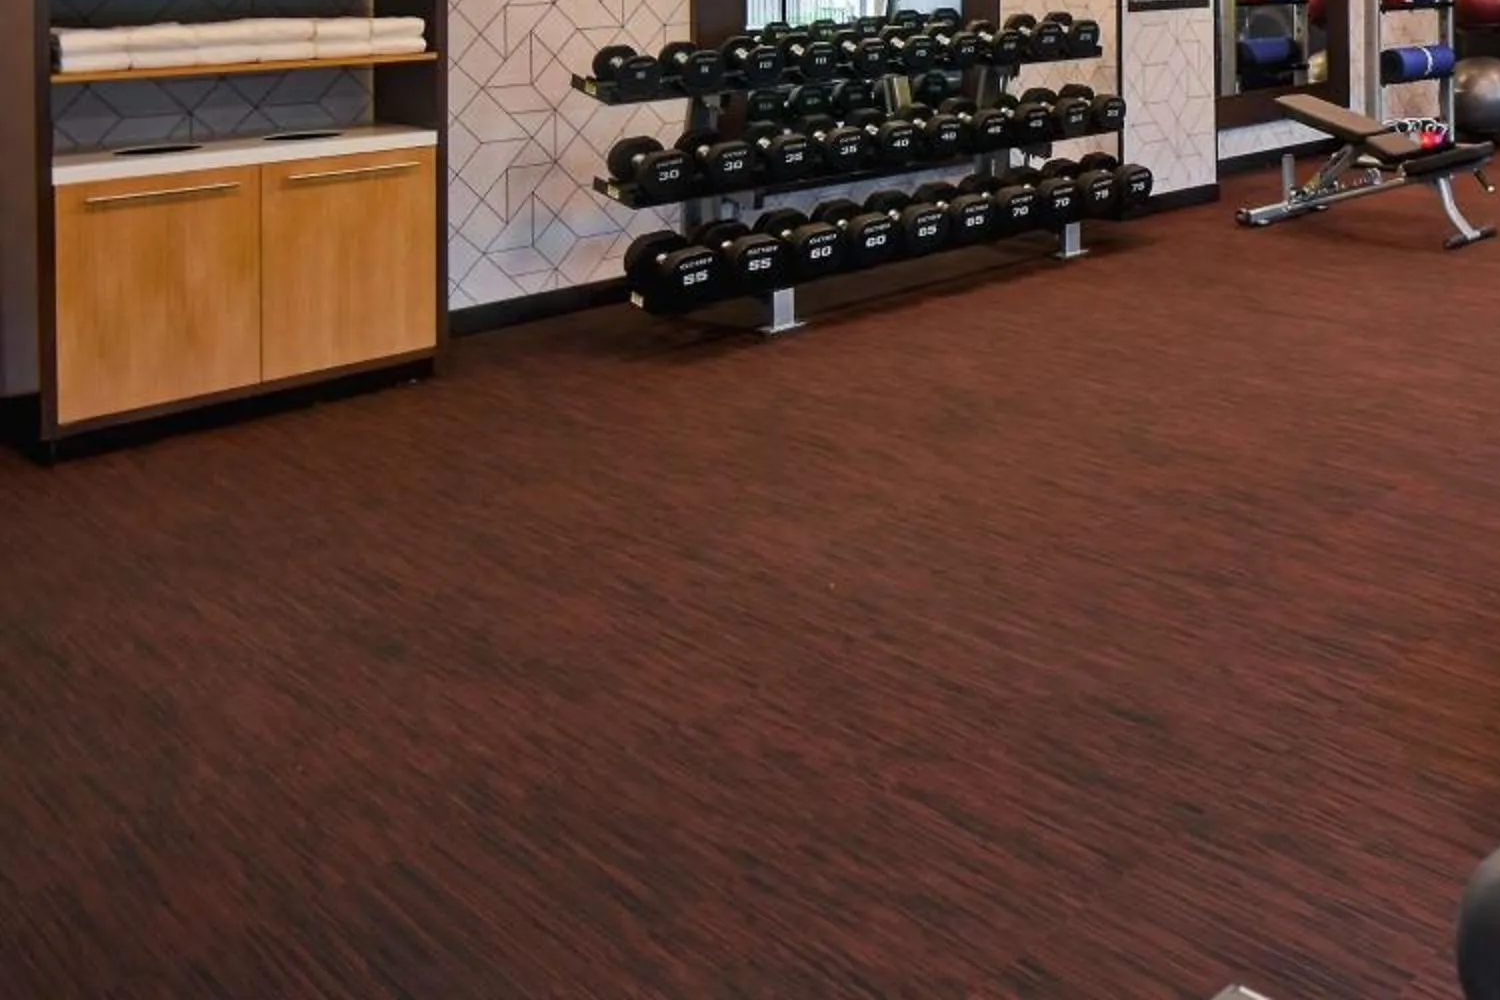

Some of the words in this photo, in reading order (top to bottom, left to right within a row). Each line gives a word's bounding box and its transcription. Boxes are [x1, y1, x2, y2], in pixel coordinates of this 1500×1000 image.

[941, 131, 958, 141] 40
[892, 138, 910, 148] 40
[840, 145, 858, 155] 35
[723, 160, 743, 172] 30
[657, 168, 681, 182] 30
[1131, 183, 1145, 192] 75
[1055, 197, 1071, 207] 70
[1012, 205, 1029, 217] 70
[865, 234, 887, 248] 60
[810, 245, 833, 259] 60
[747, 257, 773, 271] 55
[682, 269, 709, 286] 55
